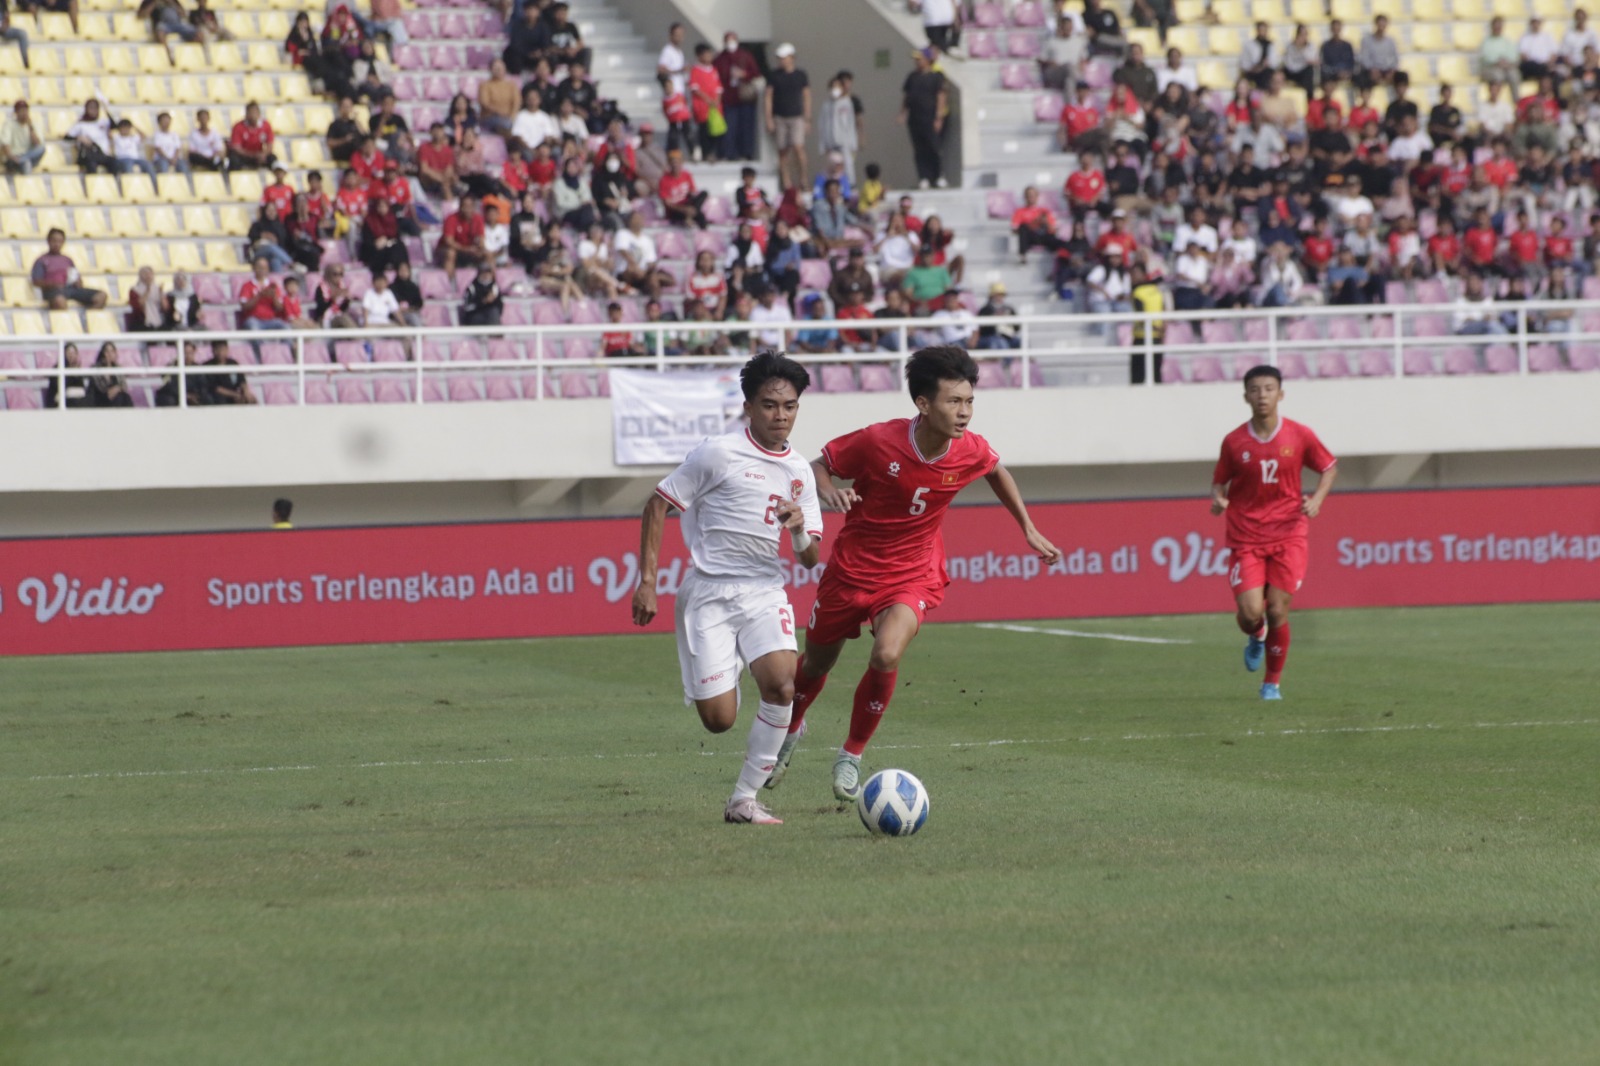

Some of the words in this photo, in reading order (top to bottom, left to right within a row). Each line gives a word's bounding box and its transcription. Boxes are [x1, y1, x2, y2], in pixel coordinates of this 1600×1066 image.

[1260, 458, 1279, 484] 12
[909, 487, 930, 516] 5
[1111, 546, 1138, 574] di
[1337, 537, 1433, 569] Sports
[1438, 532, 1600, 563] Terlengkap
[18, 572, 164, 623] Vidio
[207, 578, 303, 609] Sports
[311, 571, 475, 603] Terlengkap
[484, 569, 539, 596] Ada
[547, 565, 574, 593] di
[779, 607, 793, 636] 2
